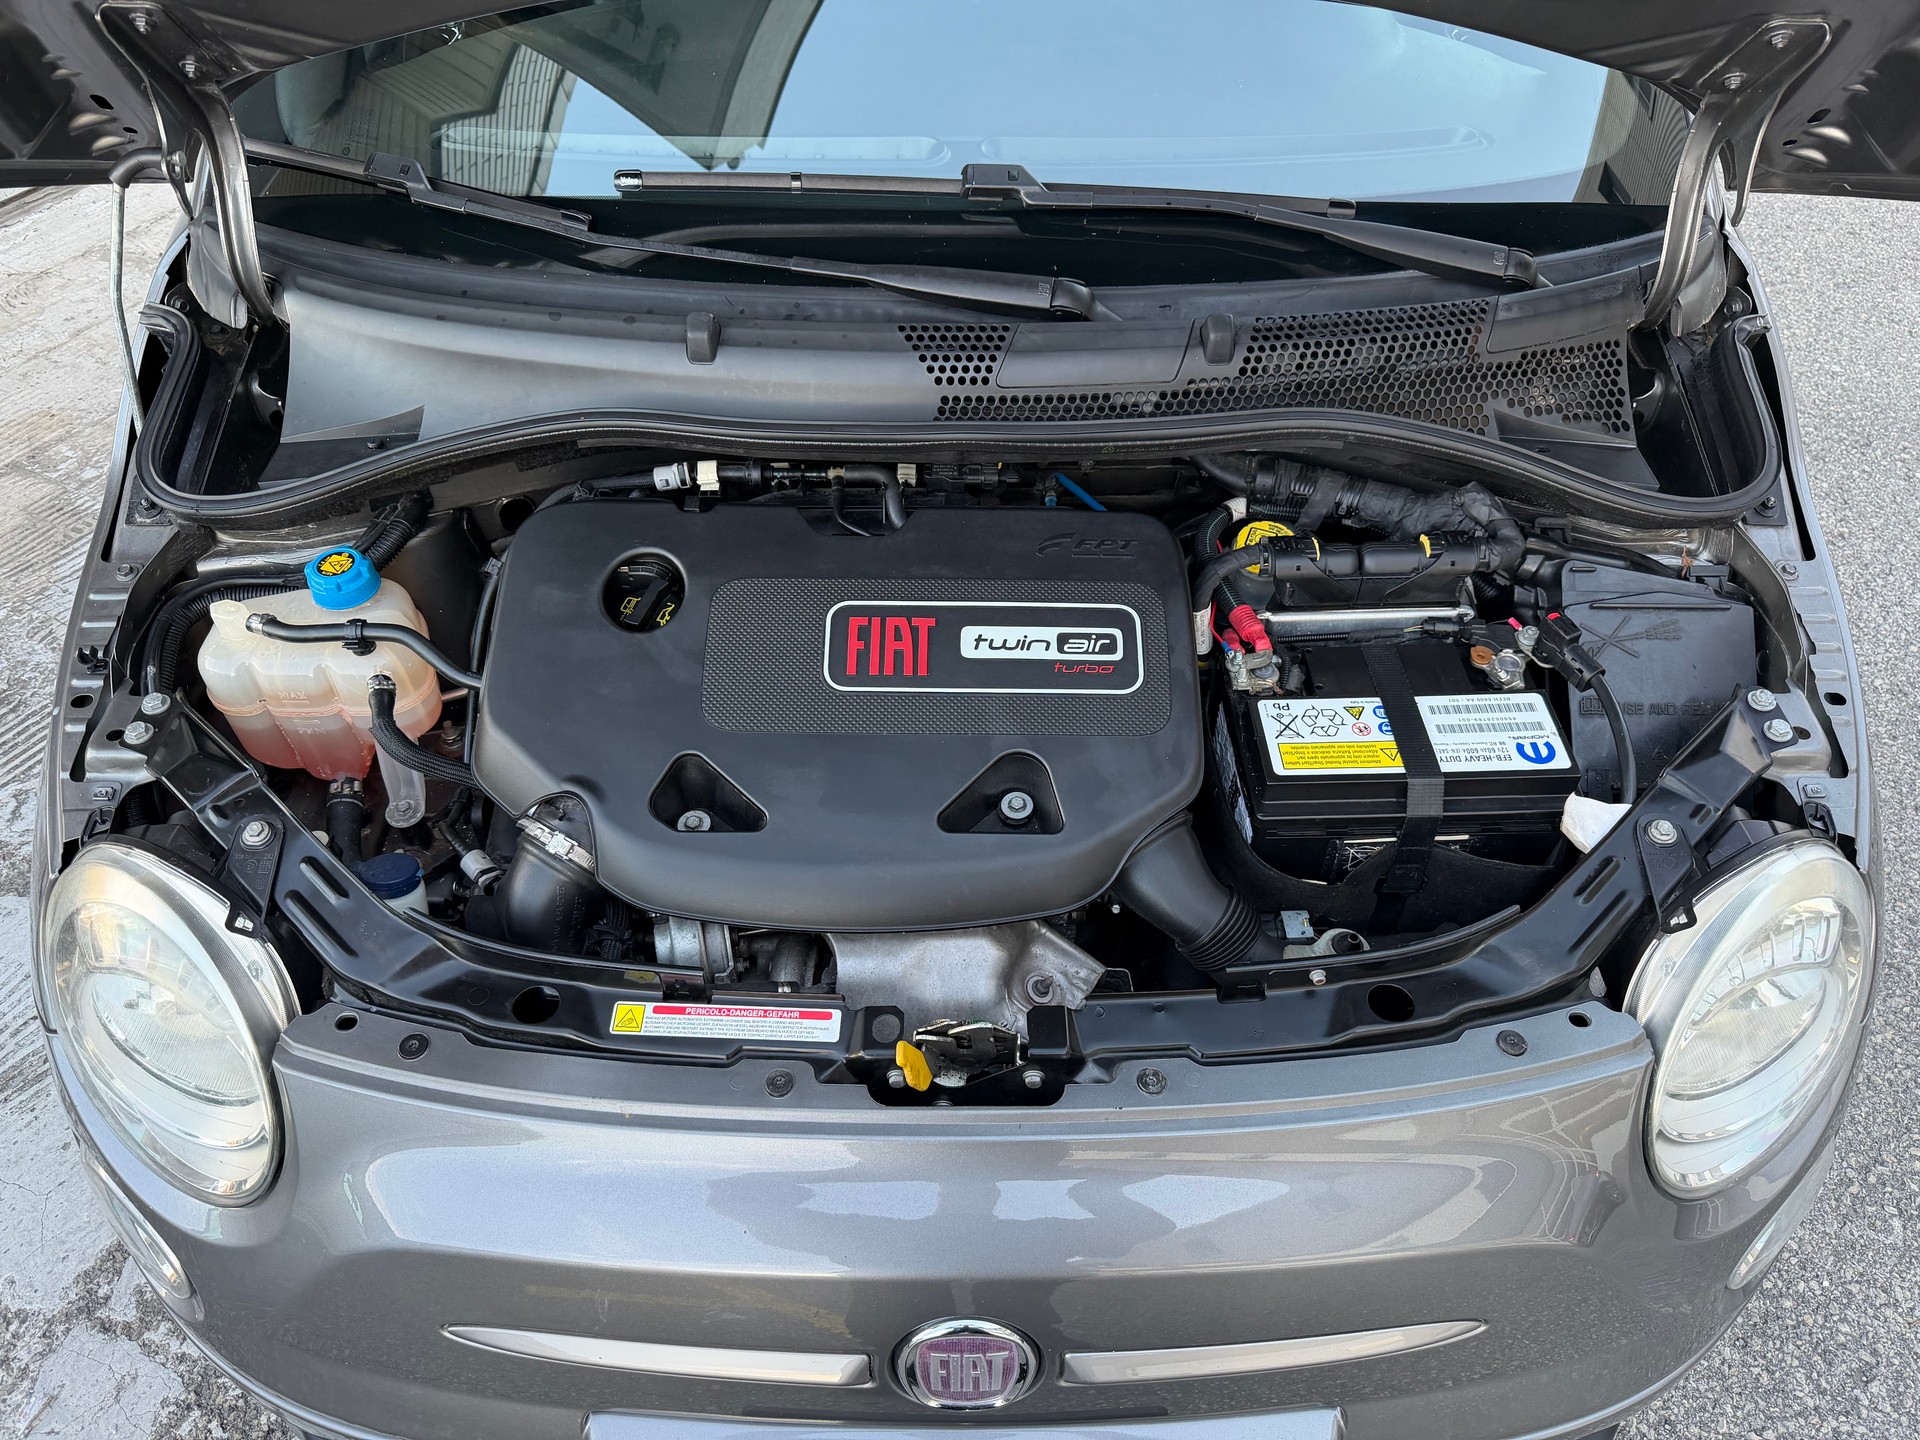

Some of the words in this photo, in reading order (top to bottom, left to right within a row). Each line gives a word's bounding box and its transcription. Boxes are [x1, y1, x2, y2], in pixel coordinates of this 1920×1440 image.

[1072, 539, 1138, 551] FPT
[846, 616, 936, 676] FIAT
[973, 634, 1051, 651] twin
[1063, 634, 1110, 653] air
[1054, 662, 1115, 674] turbo
[279, 690, 307, 700] MAX
[1272, 703, 1290, 711] Pb
[1649, 703, 1677, 716] AND
[1439, 755, 1462, 763] DUTY
[1464, 754, 1513, 763] EFB-HEAVY
[685, 1007, 800, 1019] PERICOLO-DANGER-GEFAHR
[930, 1351, 1009, 1392] FIAT
